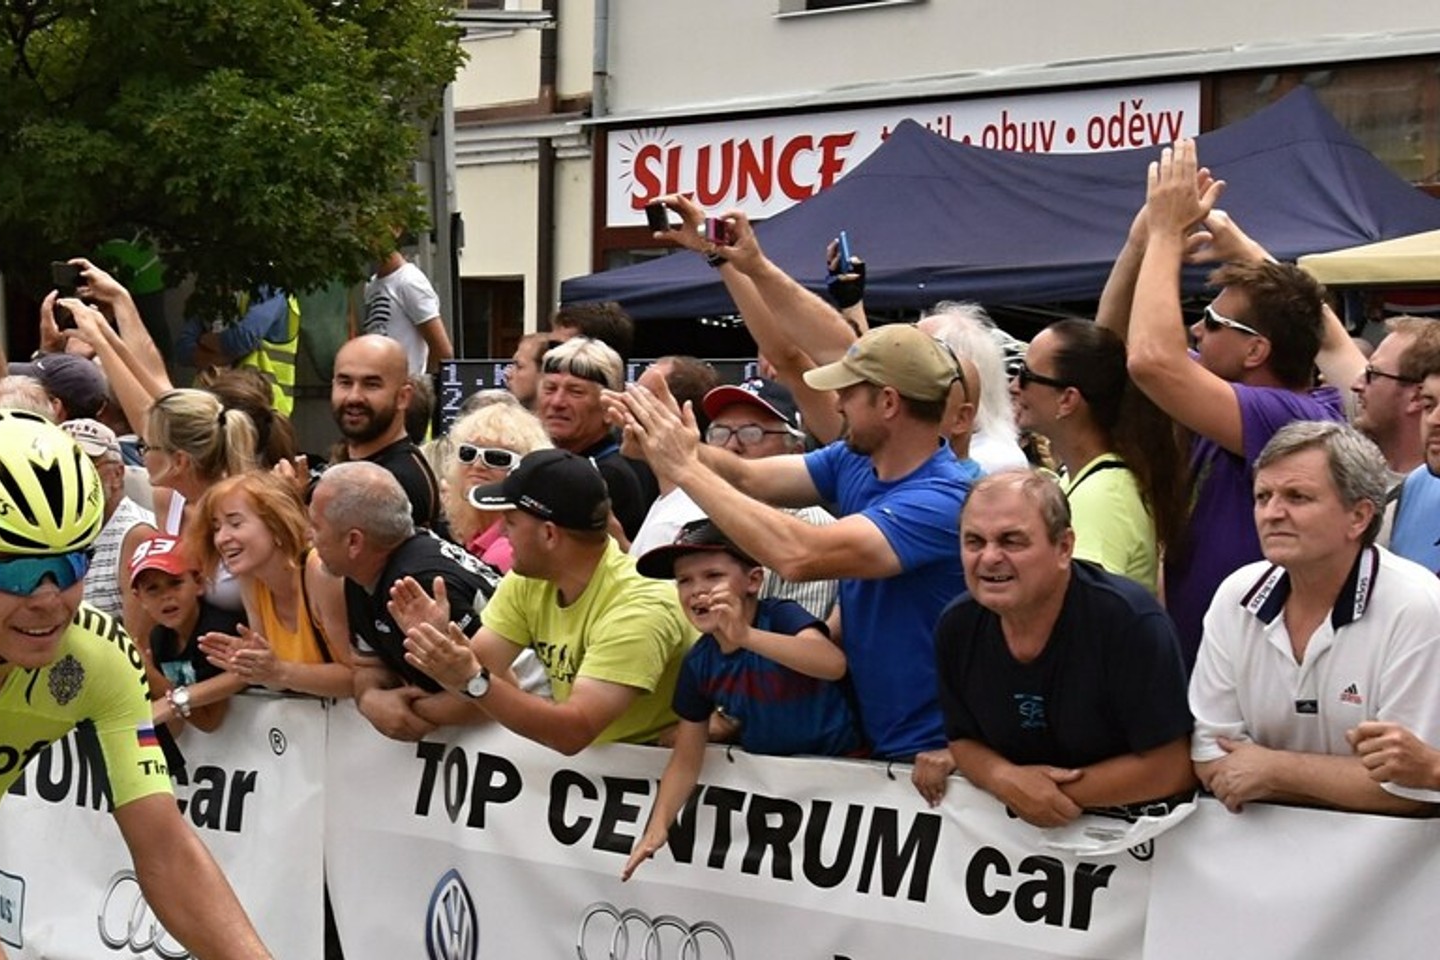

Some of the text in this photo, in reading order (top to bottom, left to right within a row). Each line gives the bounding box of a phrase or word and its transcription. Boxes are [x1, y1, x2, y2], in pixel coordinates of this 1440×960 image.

[629, 131, 857, 212] SLUNCE
[1086, 99, 1184, 151] oděvy
[132, 537, 177, 567] 93
[414, 741, 1117, 933] TOP CENTRUM car
